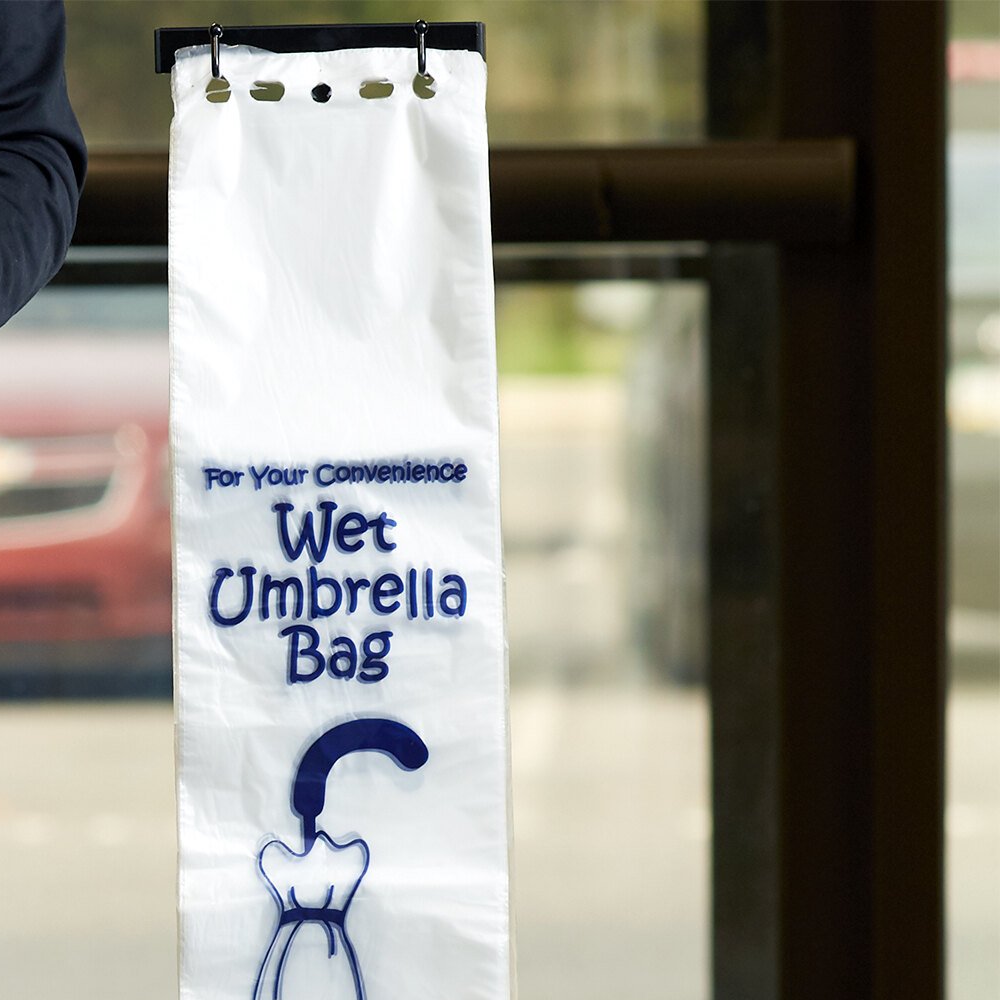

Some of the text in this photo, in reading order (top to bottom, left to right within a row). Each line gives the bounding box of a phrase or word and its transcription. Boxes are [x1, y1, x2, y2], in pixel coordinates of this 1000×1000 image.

[205, 461, 468, 488] For Your Convenience
[273, 500, 397, 564] Wet
[208, 565, 467, 627] Umbrella
[279, 624, 393, 683] Bag
